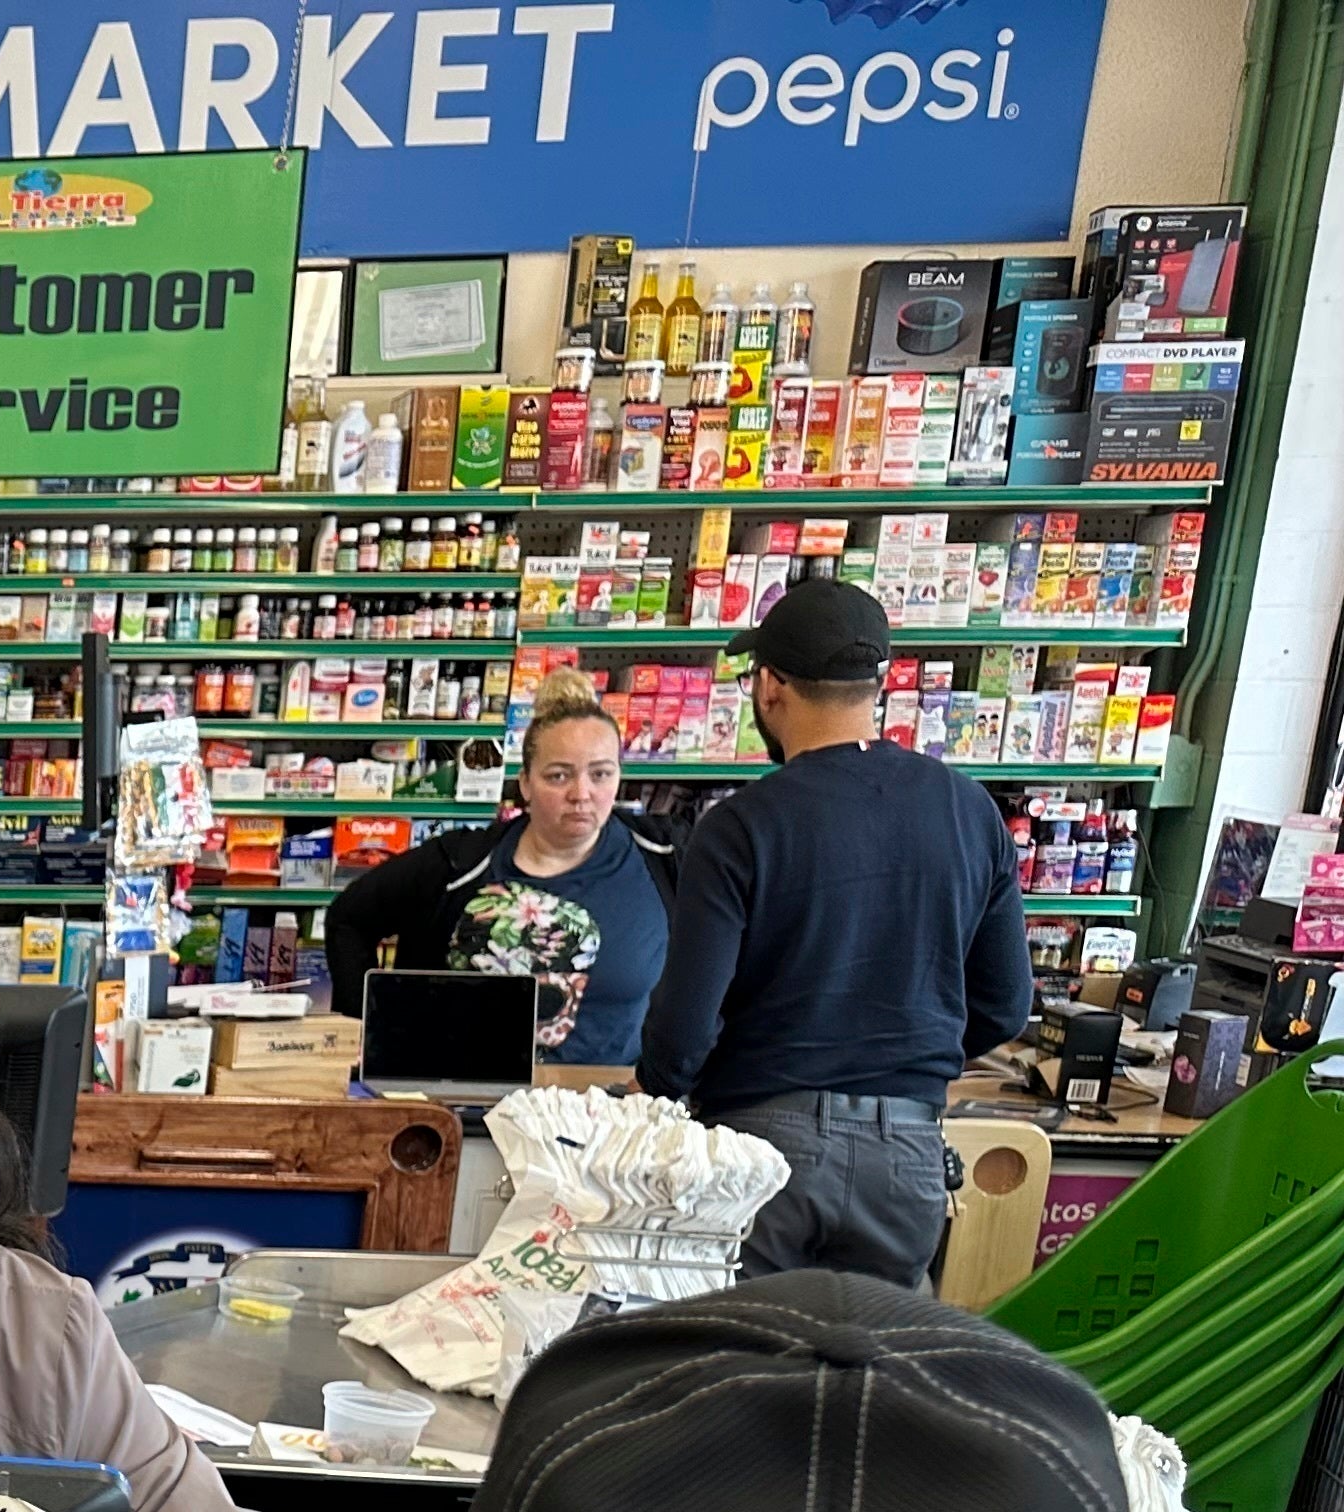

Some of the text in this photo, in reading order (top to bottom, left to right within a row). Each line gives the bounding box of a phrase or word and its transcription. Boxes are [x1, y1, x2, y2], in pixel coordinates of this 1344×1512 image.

[692, 27, 1015, 151] pepsi
[10, 190, 126, 212] Tierra
[908, 272, 964, 286] BEAM
[1106, 347, 1237, 359] COMPACT DVD PLAYER
[1090, 461, 1217, 481] SYLVANIA
